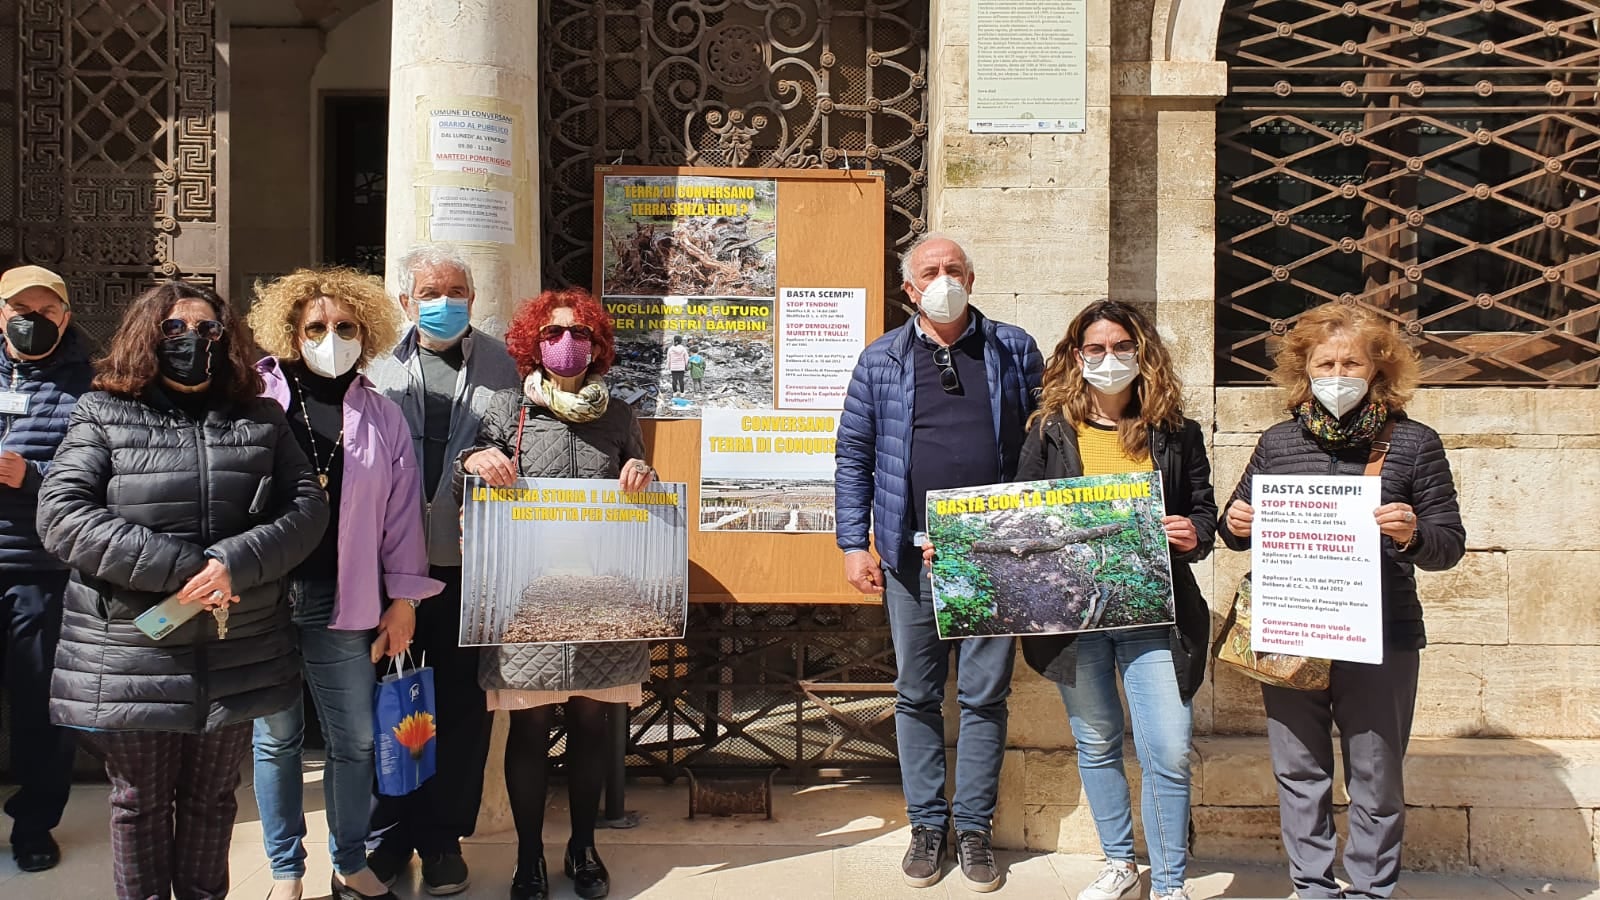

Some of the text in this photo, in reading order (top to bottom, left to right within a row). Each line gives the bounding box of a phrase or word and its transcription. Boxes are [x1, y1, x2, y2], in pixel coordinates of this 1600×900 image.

[478, 124, 508, 135] PUBBLICO
[469, 155, 511, 166] POMERIGGIO
[624, 185, 755, 199] TERRA DI CONVERSANO
[631, 203, 666, 216] TERRA
[669, 203, 704, 216] SENZA
[740, 204, 748, 216] ?
[607, 304, 770, 317] VOGLIAMO UN FUTURO
[607, 319, 766, 331] PER I NOSTRI BAMBINI
[741, 415, 835, 432] CONVERSANO
[709, 436, 837, 455] TERRA DI CONQUIS
[1262, 484, 1362, 495] BASTA SCEMPI!
[472, 487, 679, 506] LA NOSTRA STORIA E LA TRADIZIONE
[936, 482, 1151, 515] BASTA CON LA DISTRUZIONE
[1262, 500, 1338, 509] STOP TENDONI!
[512, 506, 649, 522] DISTRUTTA PER SEMPRE
[1262, 530, 1356, 542] STOP DEMOLIZIONI
[1262, 541, 1354, 553] MURETTI E TRULLI!
[1262, 618, 1351, 632] Conversano non vuole
[1262, 627, 1367, 643] diventare la Capitale delle
[1262, 637, 1304, 646] brutture!!!
